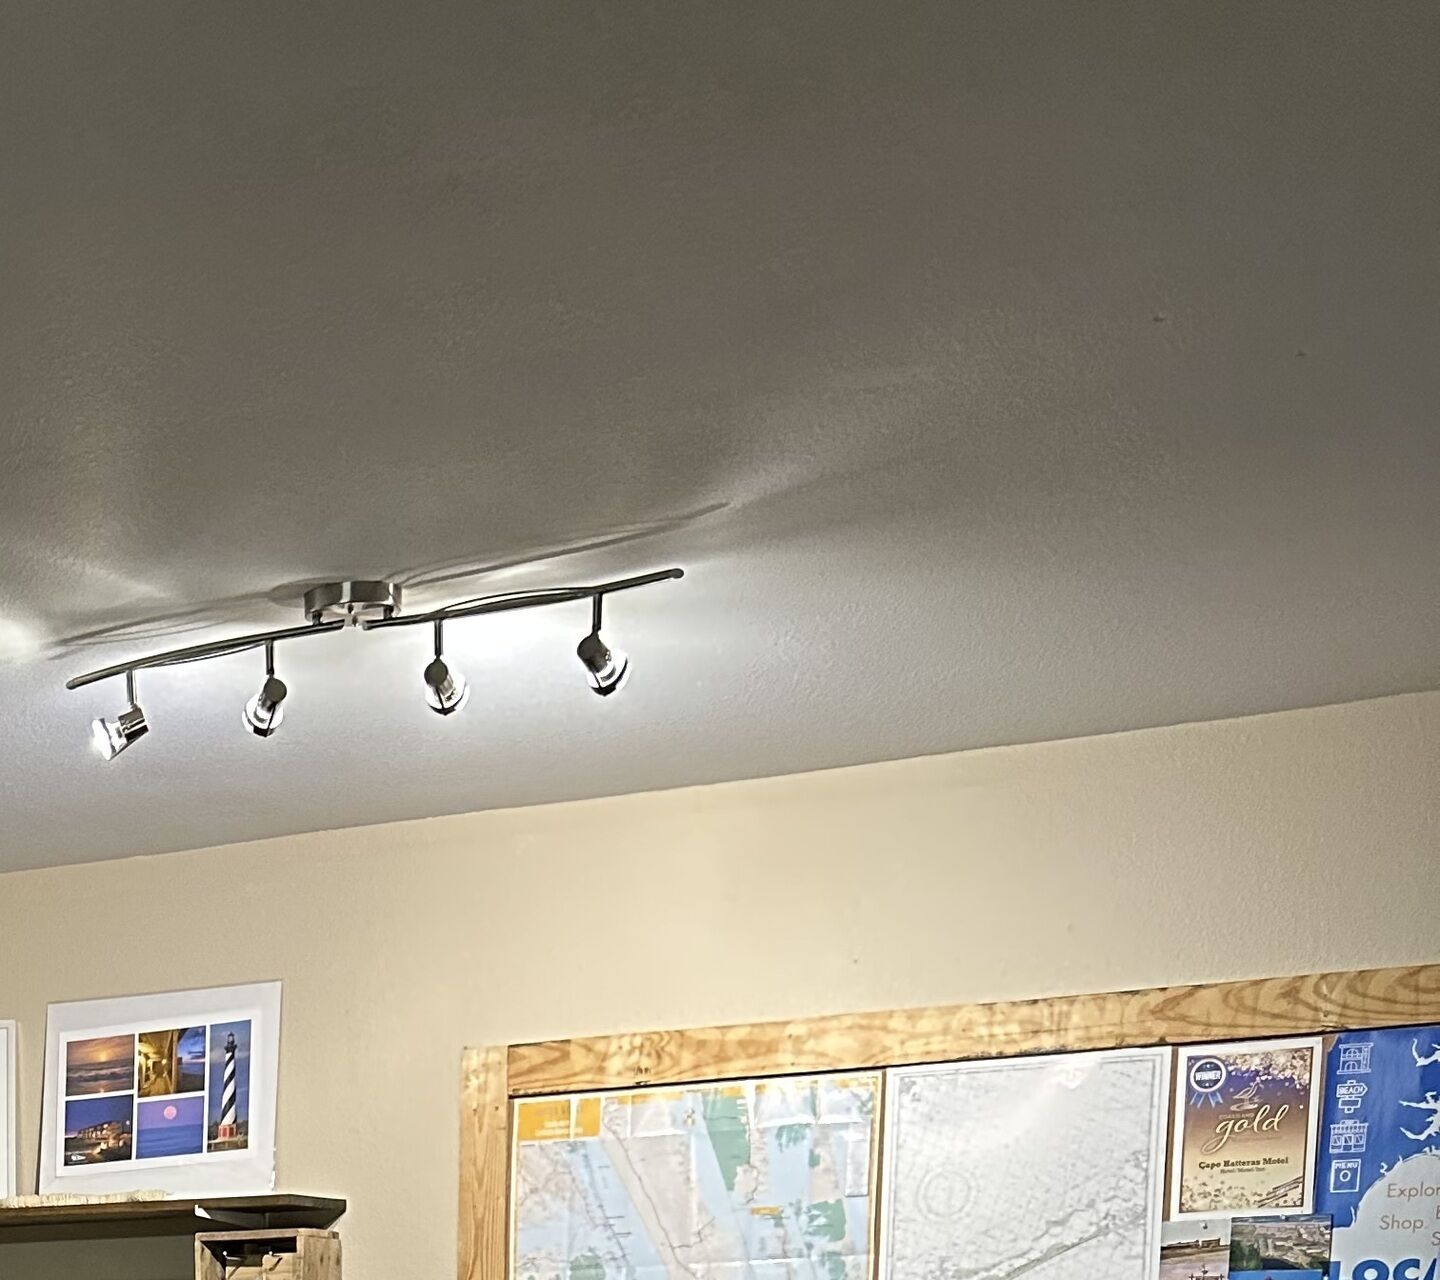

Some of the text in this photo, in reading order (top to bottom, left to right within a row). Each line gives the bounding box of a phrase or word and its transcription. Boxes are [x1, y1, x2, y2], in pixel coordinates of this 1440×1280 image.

[1338, 1085, 1364, 1096] BEACH
[1201, 1104, 1289, 1155] gold
[1334, 1160, 1358, 1169] MENU
[1379, 1215, 1424, 1233] Shop
